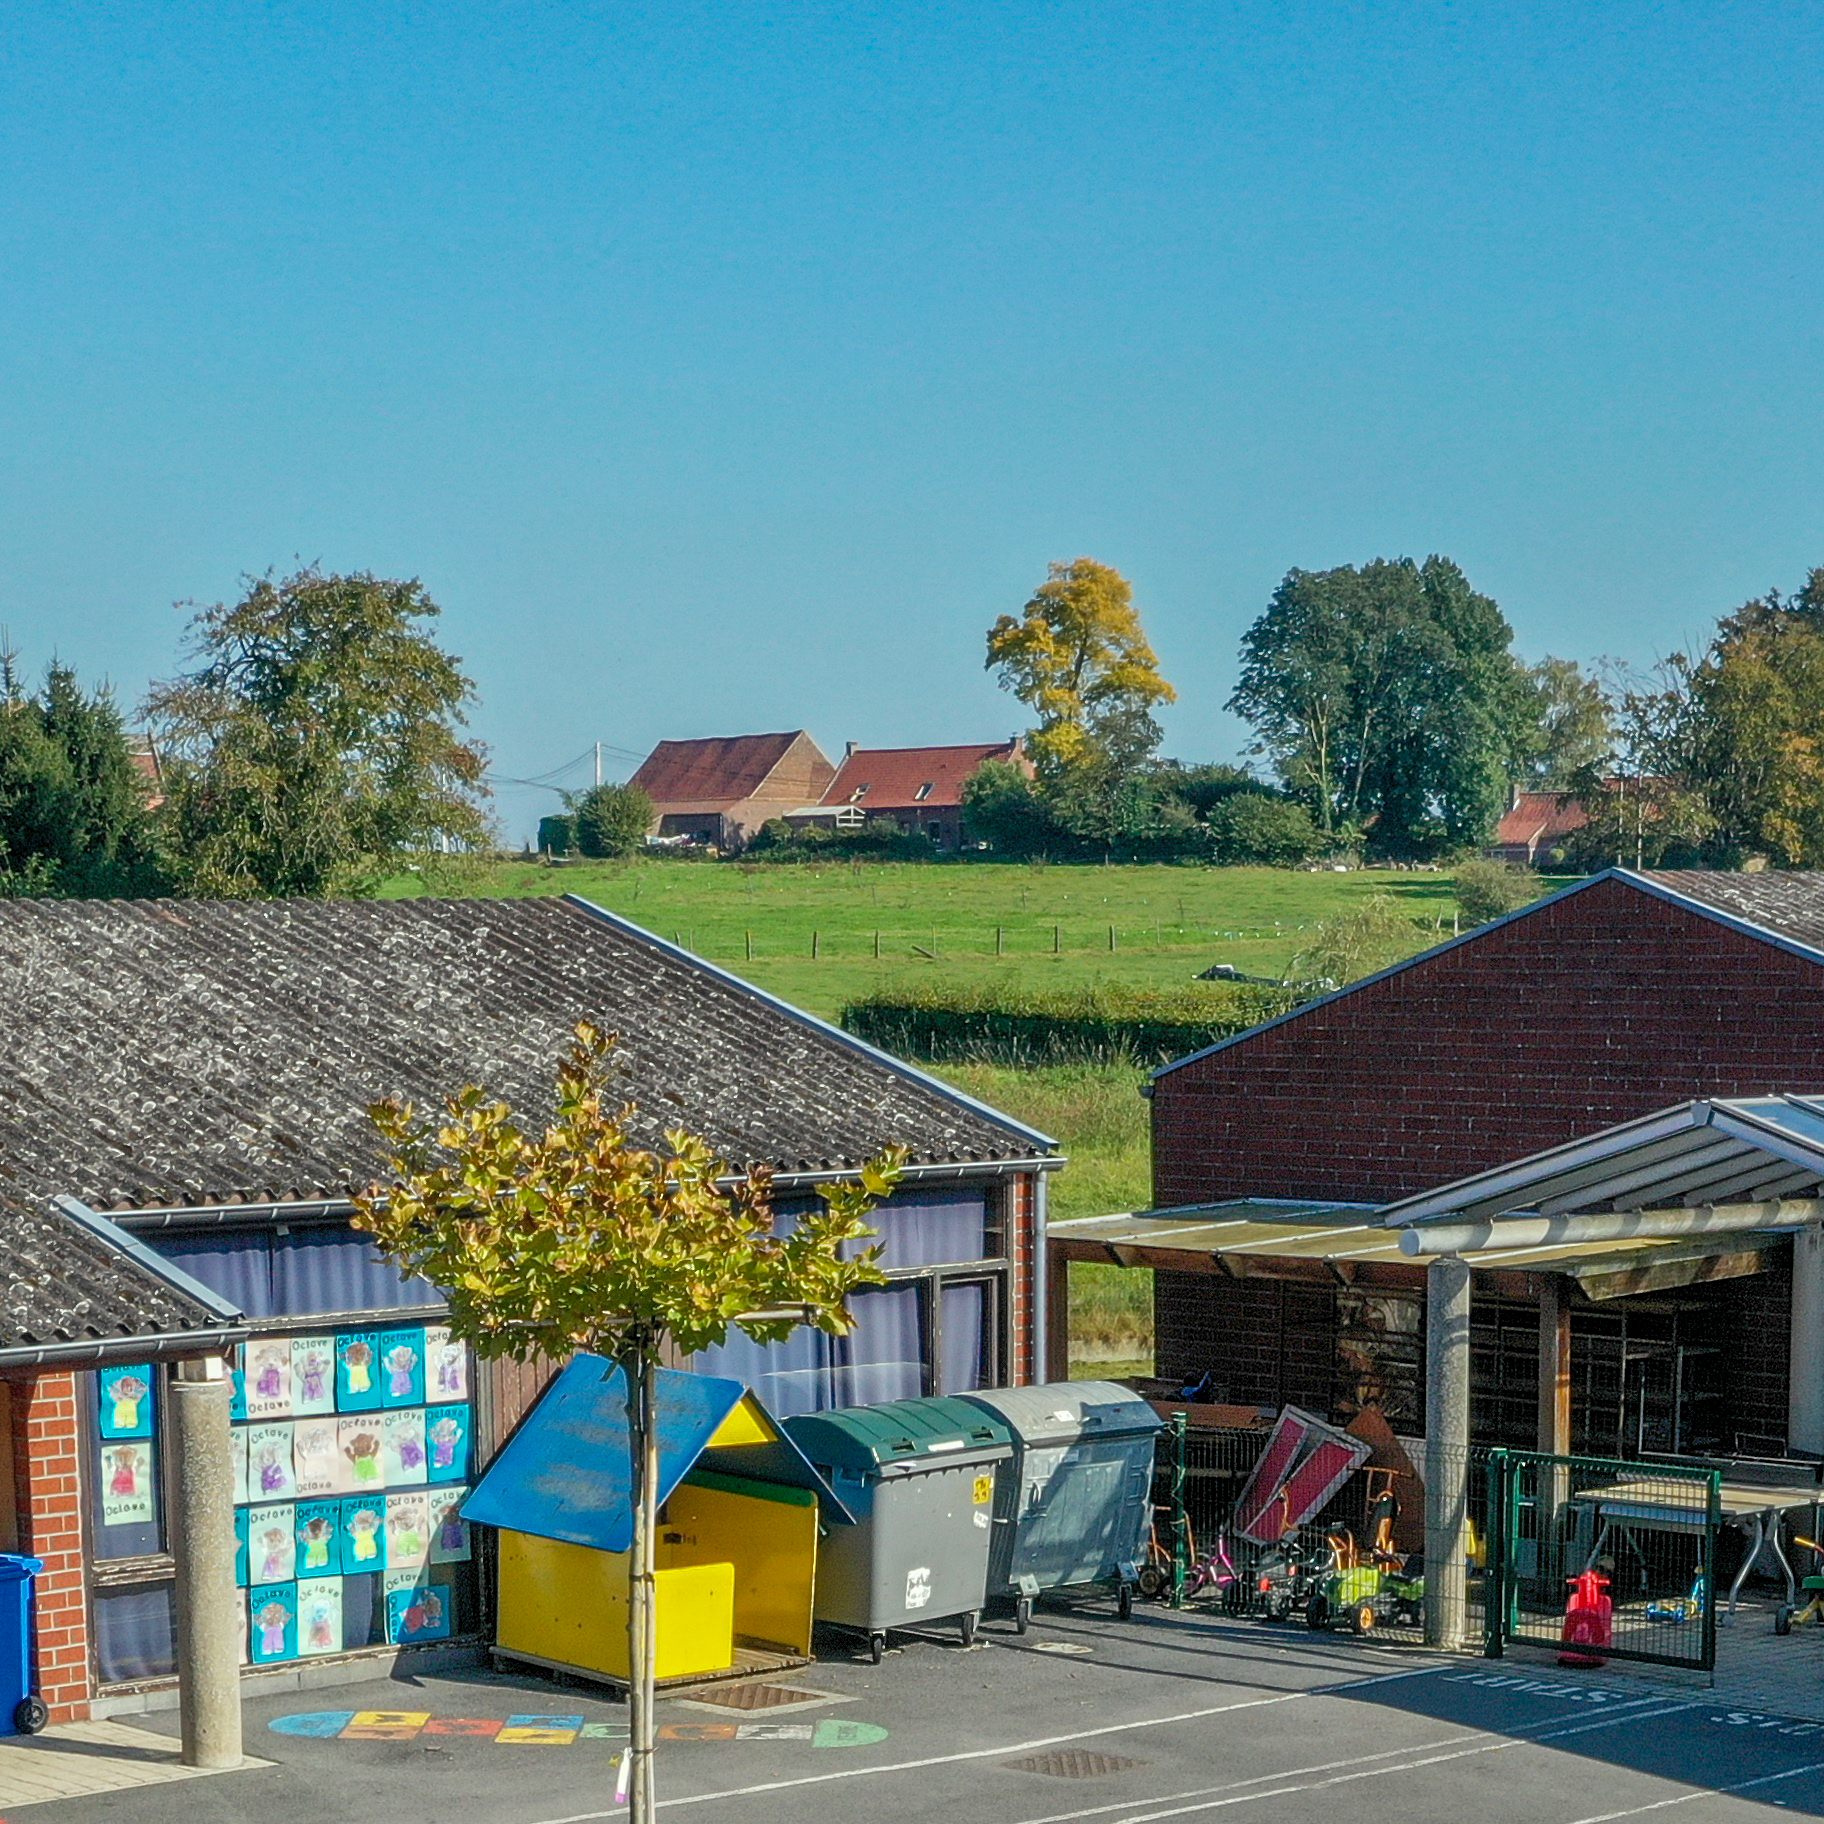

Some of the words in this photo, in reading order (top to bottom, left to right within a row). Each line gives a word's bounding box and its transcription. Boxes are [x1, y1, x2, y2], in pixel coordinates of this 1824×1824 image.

[292, 1338, 328, 1351] Octave
[337, 1333, 377, 1347] Octave
[382, 1332, 418, 1345] Octave
[426, 1331, 449, 1345] Octa
[248, 1399, 291, 1414] Octave
[384, 1411, 423, 1427] Octave
[427, 1408, 464, 1420] Octave
[341, 1418, 381, 1430] Octave
[250, 1428, 289, 1444] Octave
[296, 1481, 333, 1493] Octave
[345, 1500, 383, 1513] Octave
[386, 1495, 424, 1508] Octave
[430, 1491, 462, 1509] Octav
[105, 1503, 146, 1517] Octave
[250, 1508, 293, 1524] Octave
[297, 1504, 338, 1519] Octave
[251, 1589, 291, 1610] Octave
[298, 1585, 340, 1602] Octave
